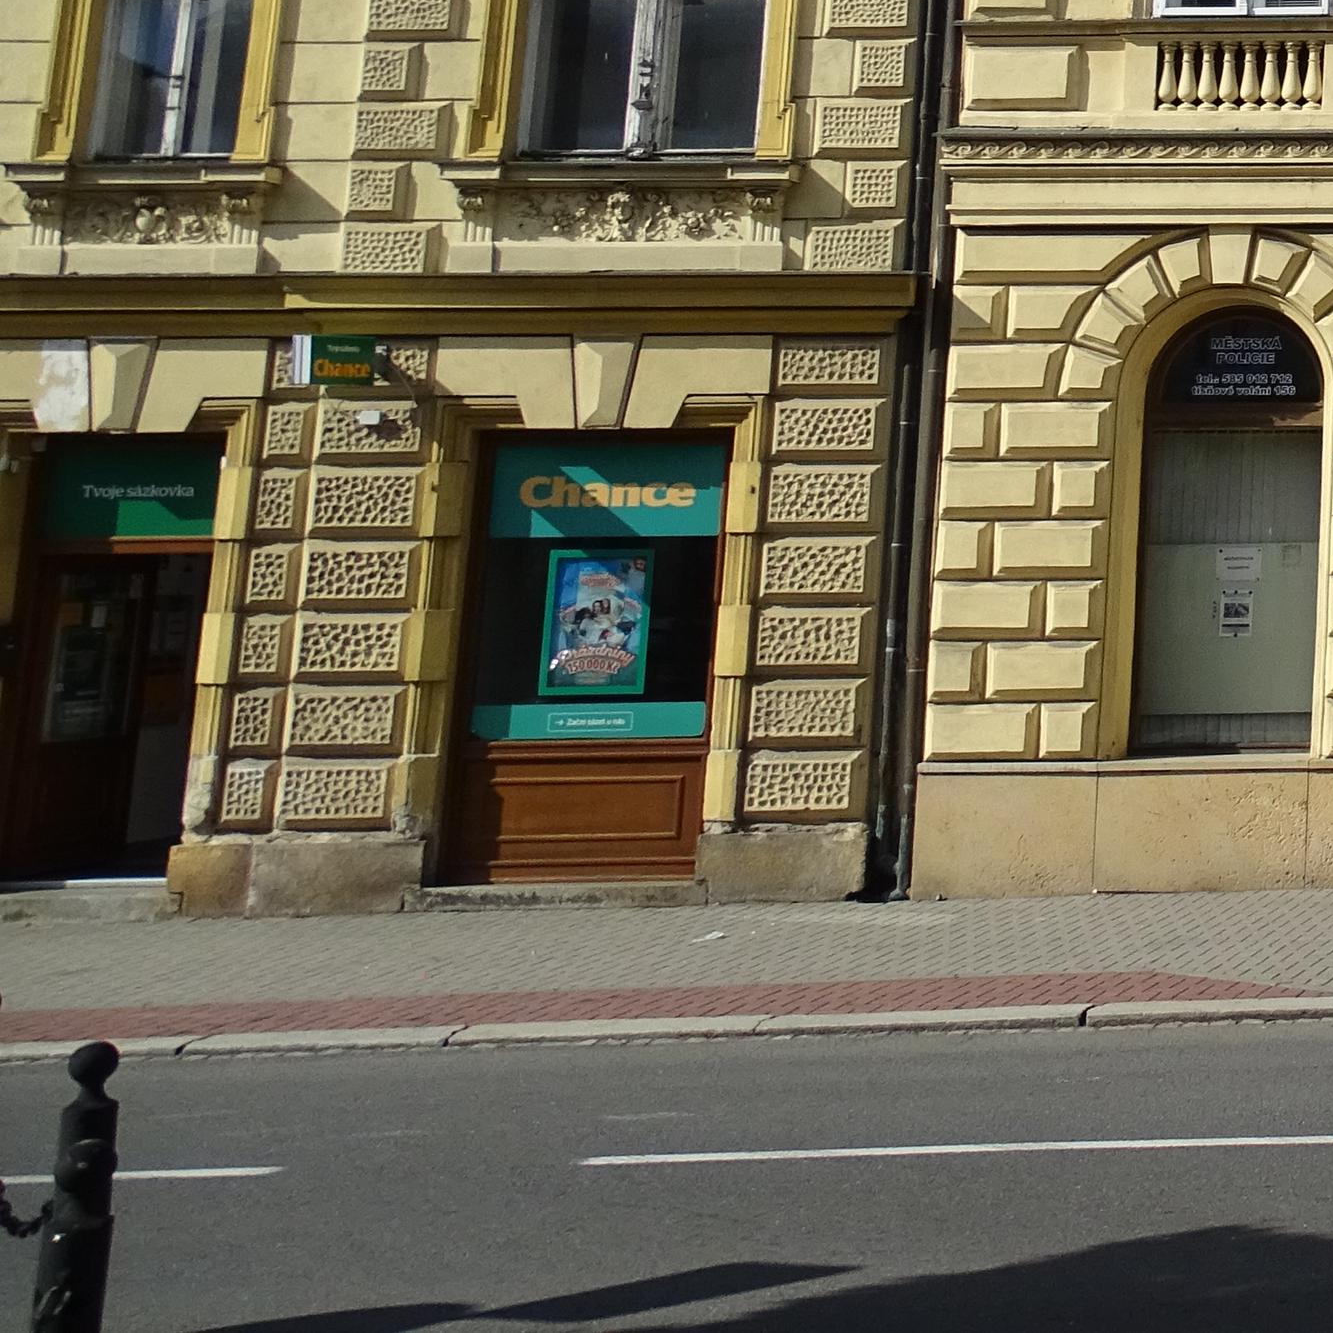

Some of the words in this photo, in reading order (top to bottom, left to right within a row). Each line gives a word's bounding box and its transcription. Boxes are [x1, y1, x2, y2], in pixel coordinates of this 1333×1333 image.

[1211, 336, 1282, 349] MĚSTSKÁ
[1216, 352, 1276, 365] POLICIE
[313, 358, 370, 378] Chance
[1270, 373, 1293, 384] 712
[82, 485, 124, 499] Tvoje
[519, 475, 698, 508] Chance
[586, 658, 606, 671] 000
